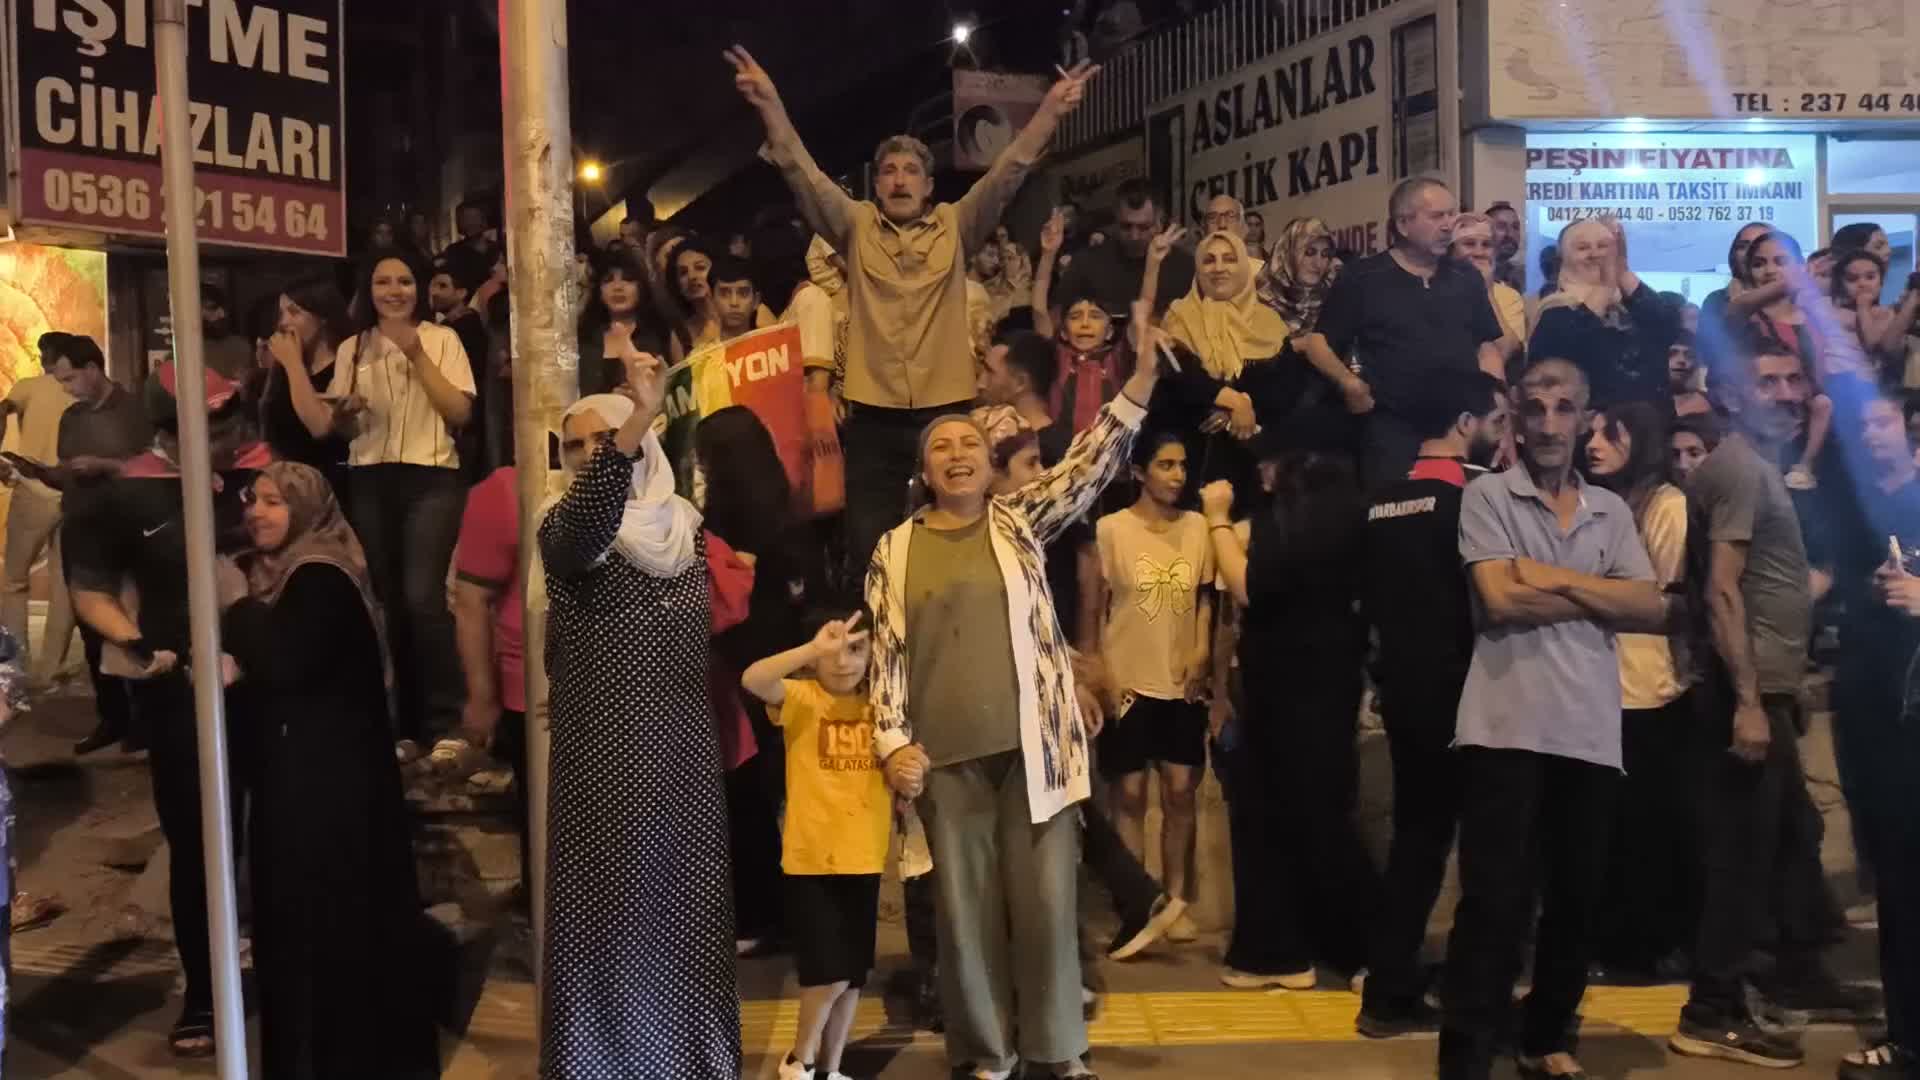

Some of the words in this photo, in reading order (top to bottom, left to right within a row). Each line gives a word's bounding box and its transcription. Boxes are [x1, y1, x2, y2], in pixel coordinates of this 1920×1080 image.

[1192, 35, 1376, 153] ASLANLAR
[1732, 92, 1773, 112] TEL
[1801, 92, 1847, 112] 237
[1858, 92, 1891, 112] 44
[1900, 92, 1920, 112] 4
[35, 66, 331, 181] CİHAZLARI
[1287, 125, 1379, 197] KAPI
[1526, 141, 1625, 176] PEŞİN
[1639, 141, 1795, 169] FİYATINA
[43, 168, 150, 220] 0536
[160, 185, 223, 229] 21
[231, 193, 277, 235] 54
[284, 200, 328, 240] 64
[1547, 206, 1580, 221] 0412
[1615, 206, 1632, 221] 44
[1637, 206, 1653, 221] 40
[1668, 206, 1701, 221] 0532
[1708, 206, 1732, 221] 762
[1737, 206, 1753, 221] 37
[1579, 182, 1660, 200] KARTINA
[727, 343, 790, 388] YON
